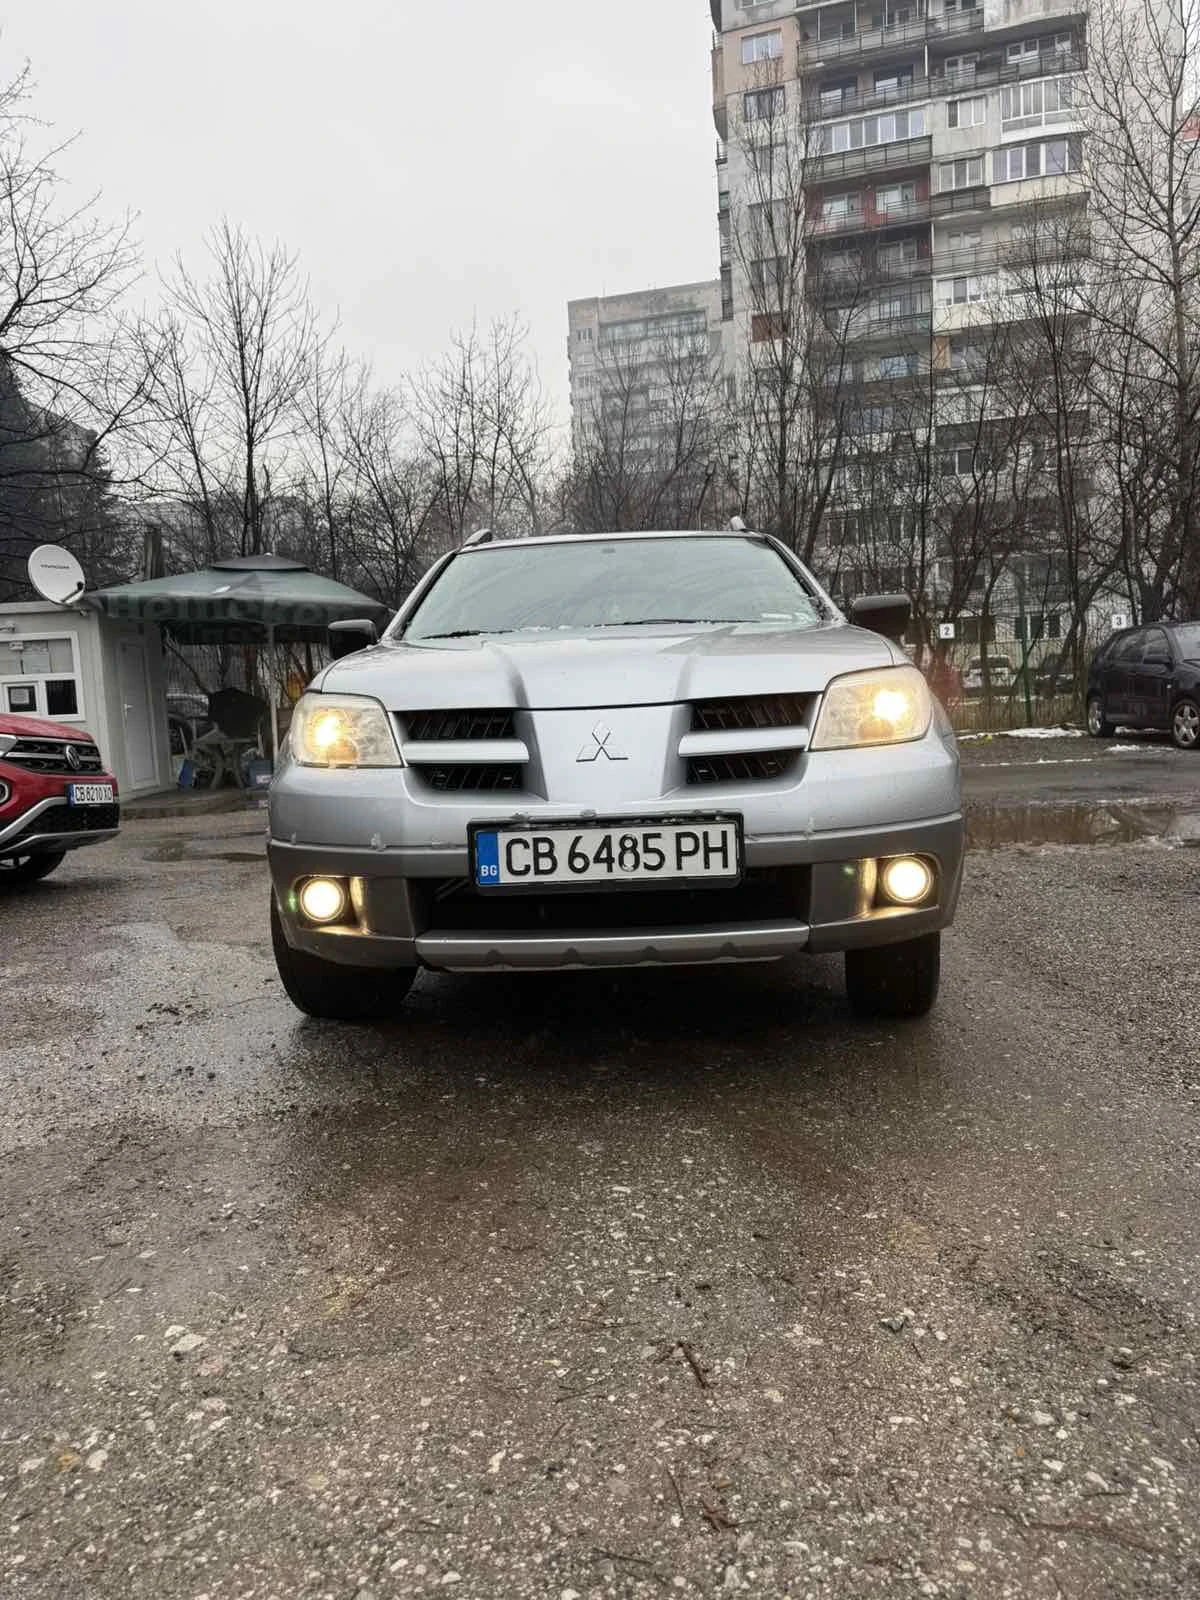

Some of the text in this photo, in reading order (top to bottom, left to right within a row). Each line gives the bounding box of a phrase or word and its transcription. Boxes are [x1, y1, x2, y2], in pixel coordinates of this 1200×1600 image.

[75, 786, 85, 801] CB
[505, 829, 729, 876] CB 6485 PH
[480, 863, 498, 877] BG
